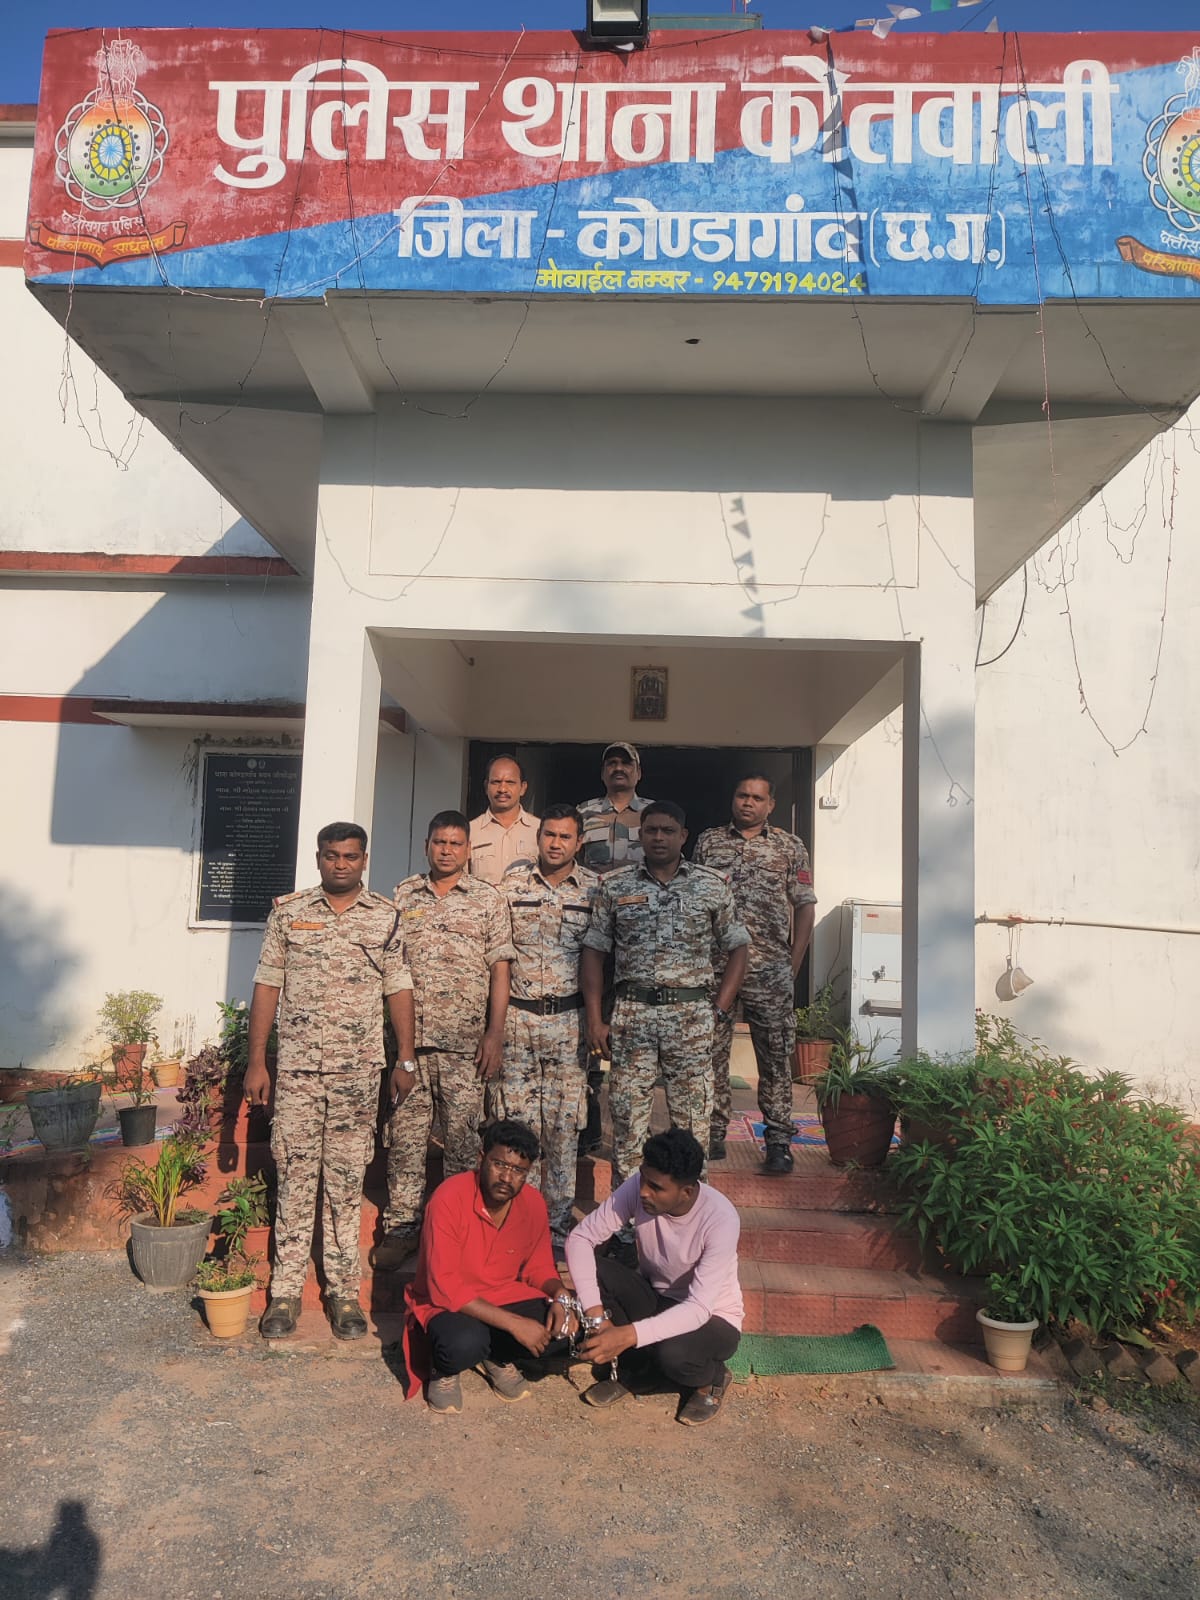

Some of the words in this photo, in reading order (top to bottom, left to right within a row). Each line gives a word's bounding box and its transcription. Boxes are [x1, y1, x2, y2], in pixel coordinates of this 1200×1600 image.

[208, 58, 480, 189] पुलिस
[501, 76, 726, 163] थाना
[739, 55, 1120, 166] कोतवाली
[393, 195, 538, 258] जिला
[577, 193, 867, 263] कोण्डागांव
[1160, 230, 1200, 254] छत्तीस
[536, 258, 625, 293] मोबाईल
[627, 270, 691, 292] नम्बर
[712, 270, 866, 292] 9479194024
